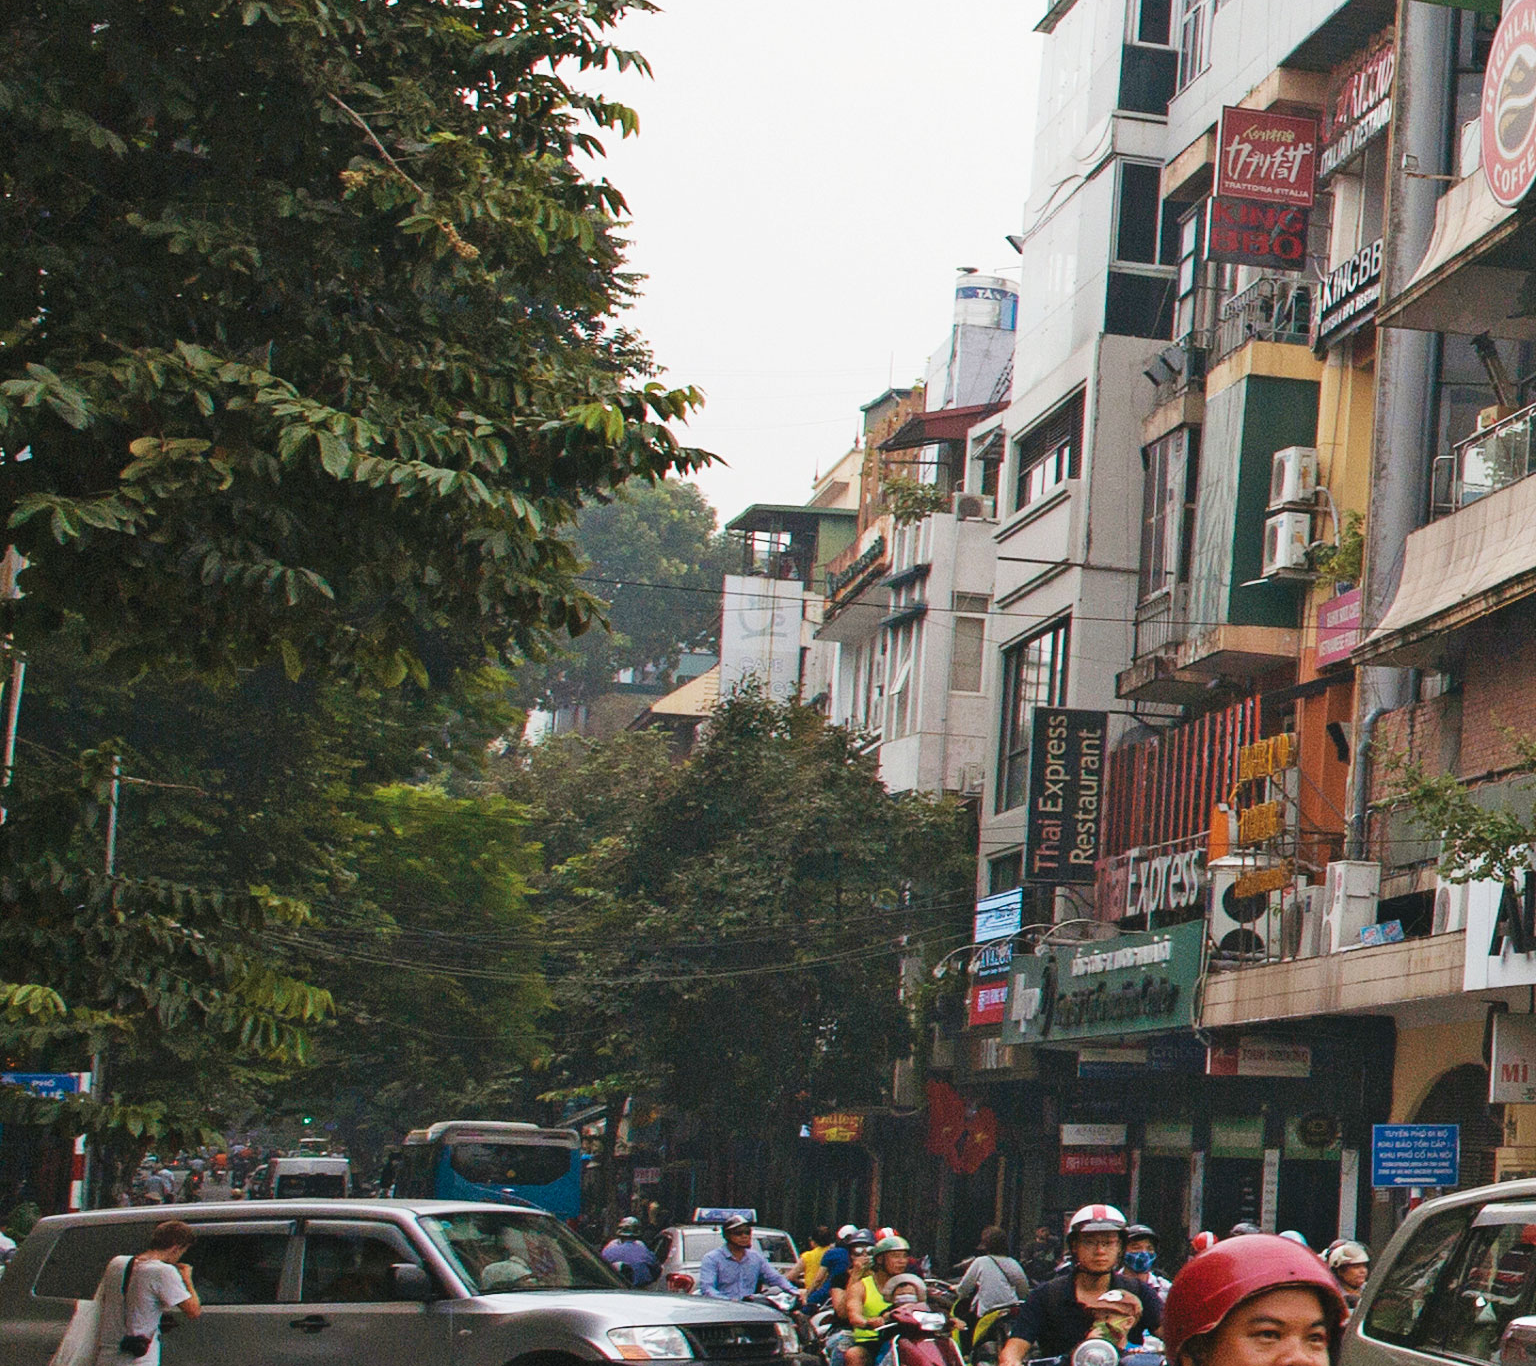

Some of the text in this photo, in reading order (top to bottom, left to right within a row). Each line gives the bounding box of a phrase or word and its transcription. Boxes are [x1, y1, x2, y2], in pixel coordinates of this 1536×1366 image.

[1212, 201, 1304, 234] KING
[1034, 715, 1070, 873] Thai Express
[1069, 729, 1100, 865] Restaurant
[1126, 848, 1200, 916] Express
[1501, 1059, 1528, 1083] MÌ
